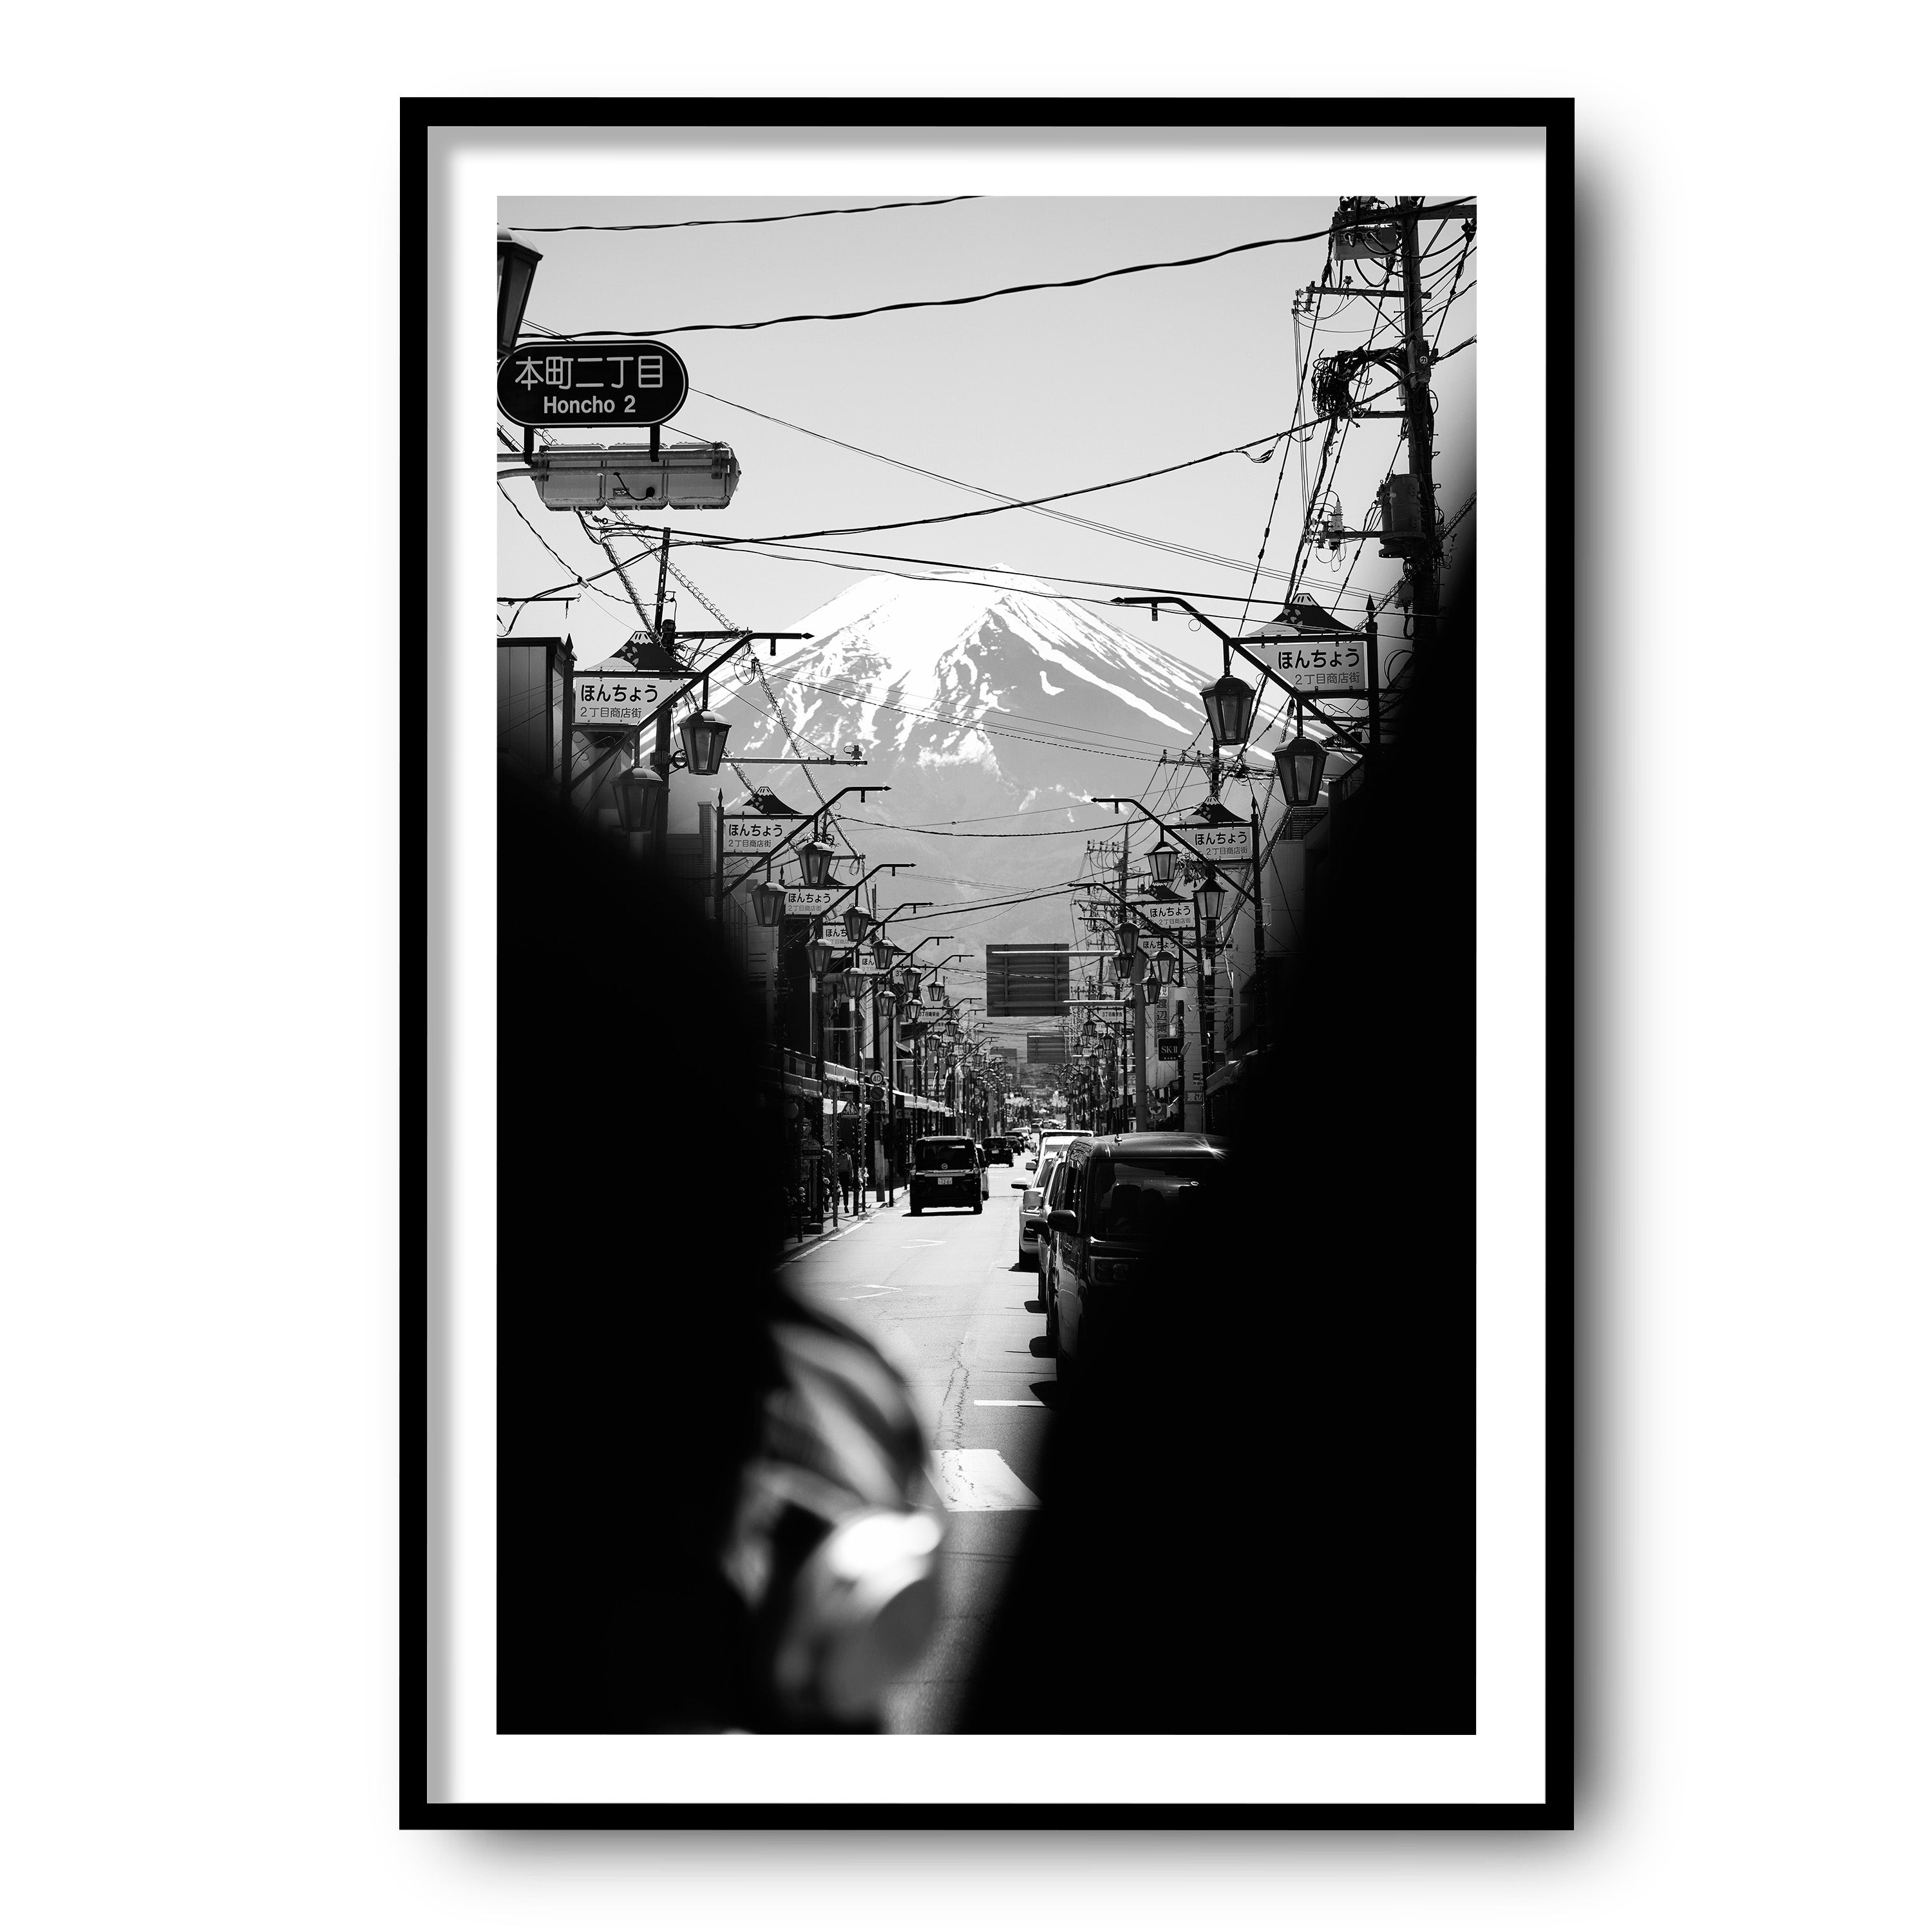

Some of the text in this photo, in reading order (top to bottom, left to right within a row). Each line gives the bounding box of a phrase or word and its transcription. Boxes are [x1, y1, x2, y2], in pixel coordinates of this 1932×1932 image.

[515, 355, 663, 391] 本町二丁目
[544, 395, 636, 414] Honcho 2
[1278, 648, 1360, 669] ほんちょう
[1294, 672, 1360, 685] 2丁目商店街
[581, 684, 658, 703] ほんちょう
[580, 706, 642, 719] 2丁目商店街
[728, 823, 783, 837] ほんちょう
[728, 839, 772, 848] 2丁目商店街
[1195, 831, 1247, 846] ほんちょう
[1206, 846, 1248, 856] 2丁目商店街
[788, 892, 831, 904] ほんちょう
[1150, 905, 1191, 917] ほんちょう
